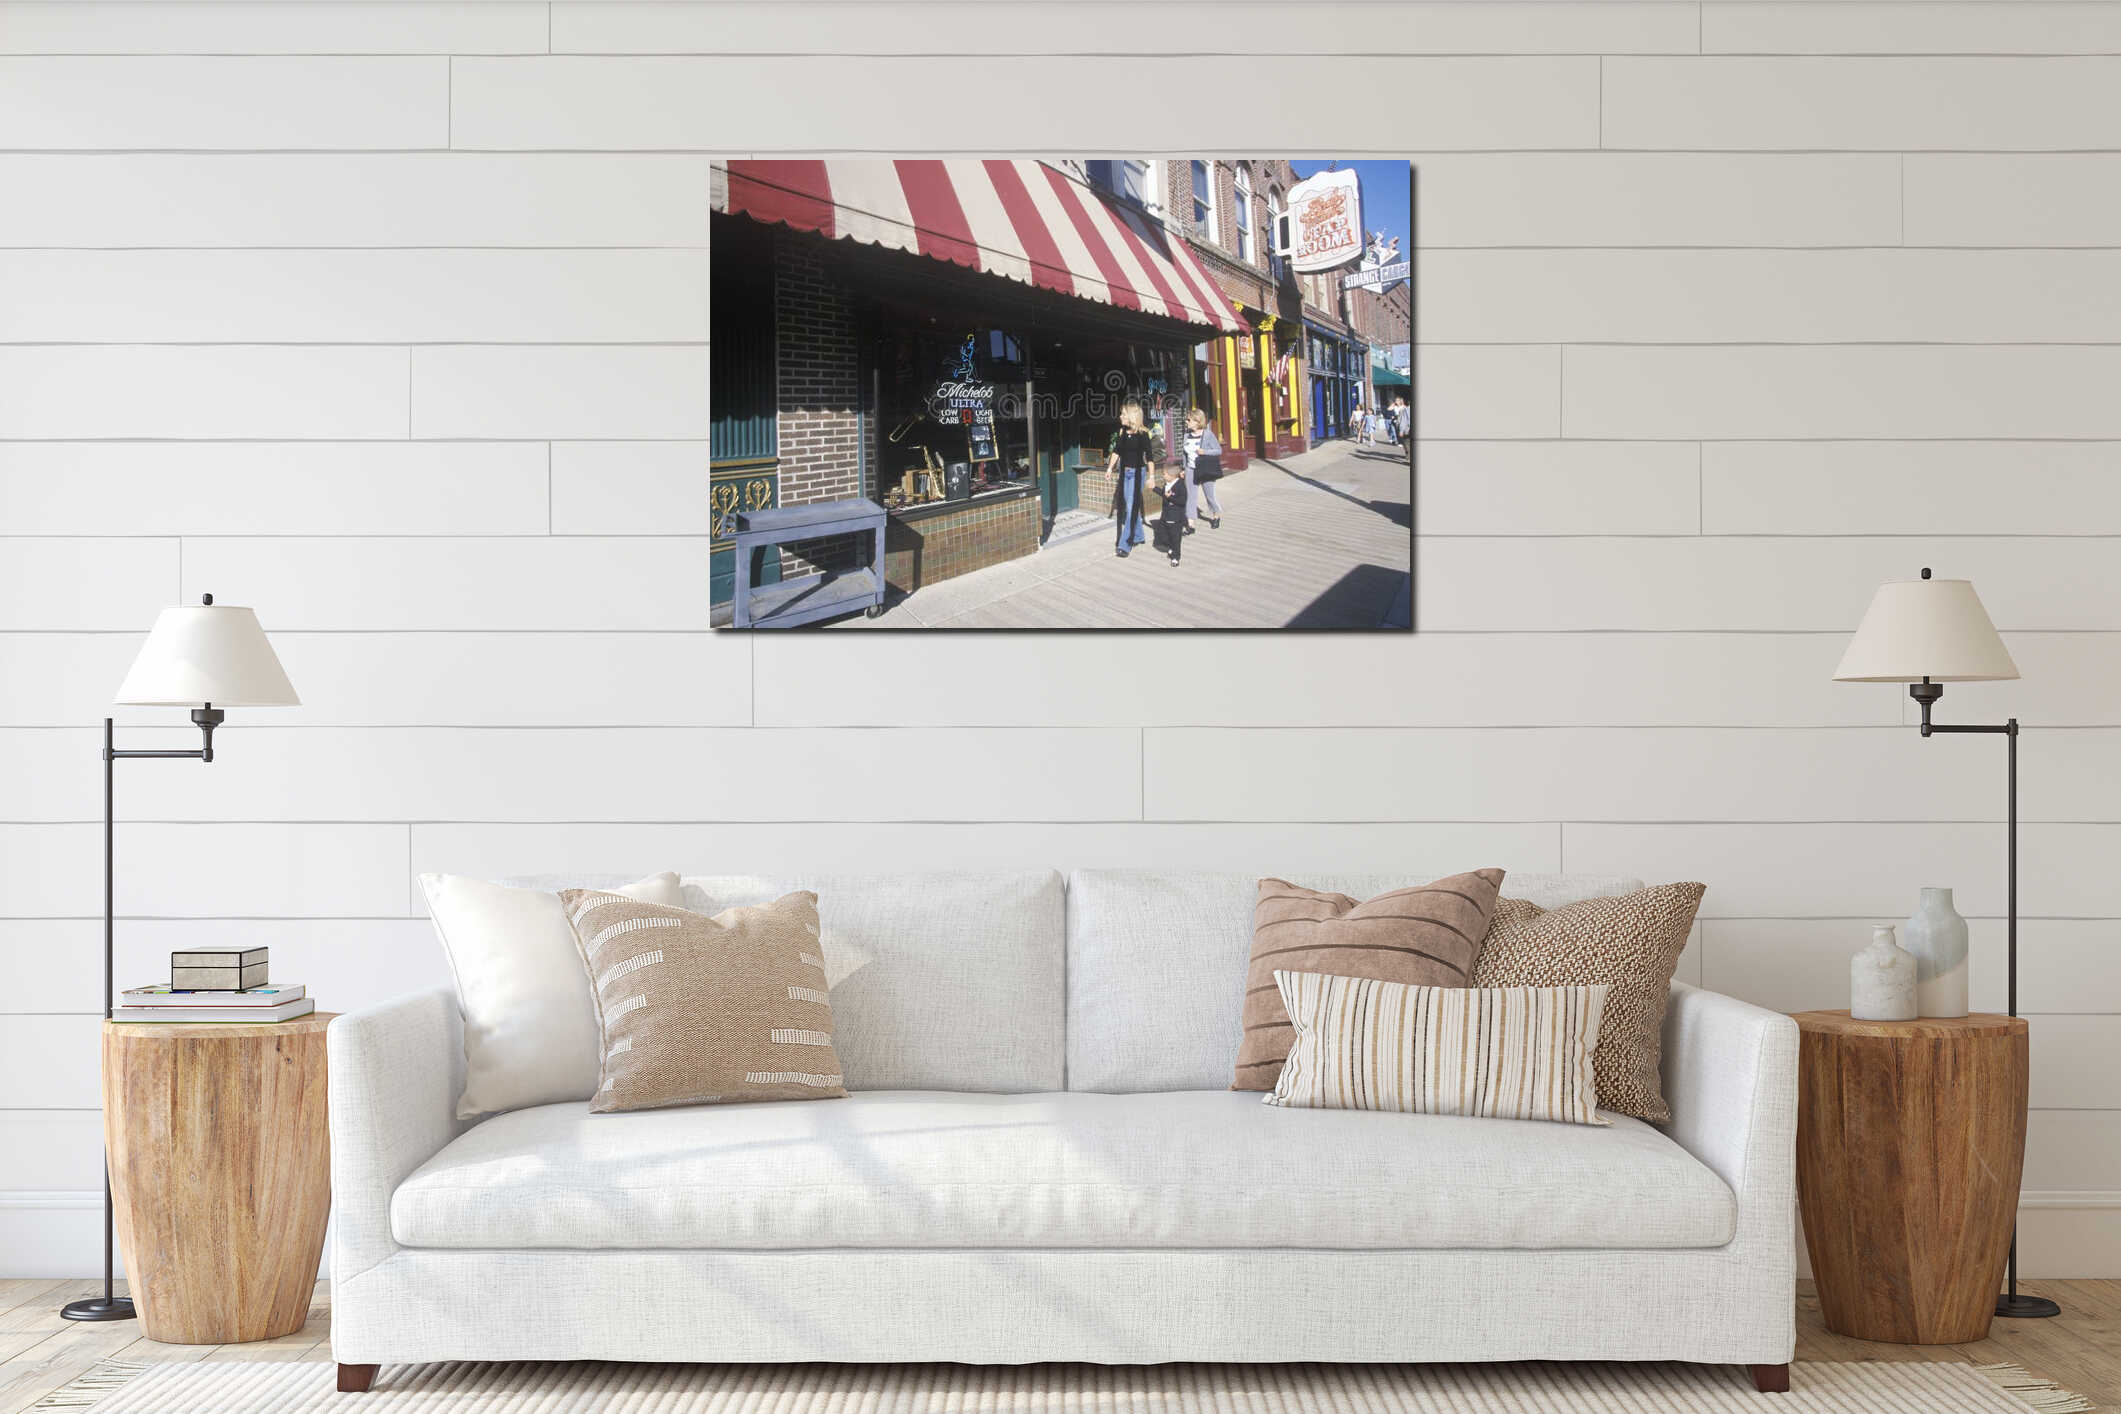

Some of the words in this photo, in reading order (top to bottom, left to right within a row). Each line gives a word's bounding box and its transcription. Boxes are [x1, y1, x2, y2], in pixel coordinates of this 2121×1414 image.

[1297, 229, 1353, 257] ROOM
[1344, 270, 1379, 288] STRANGE
[937, 382, 993, 398] Michelob
[950, 399, 983, 408] ULTRA
[941, 409, 958, 417] LOW
[975, 409, 993, 417] LIGHT
[939, 416, 959, 424] CARB
